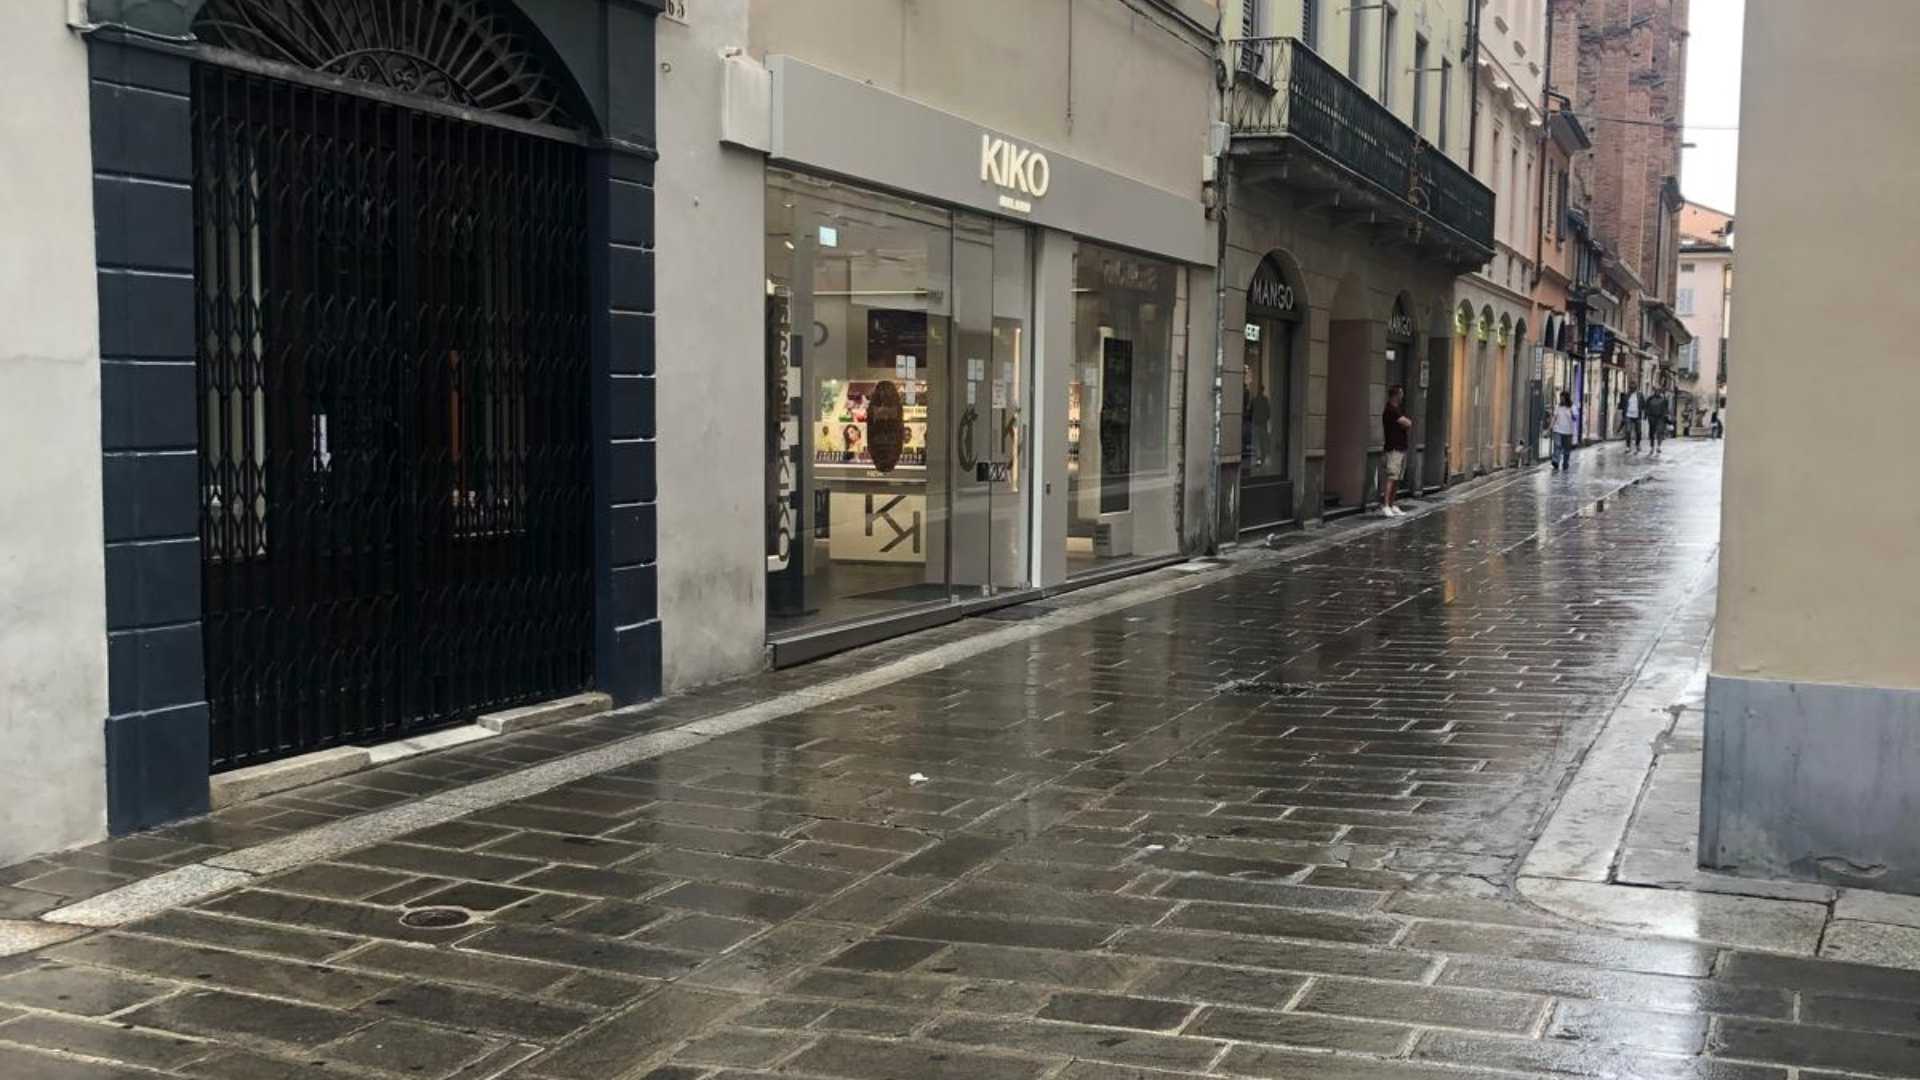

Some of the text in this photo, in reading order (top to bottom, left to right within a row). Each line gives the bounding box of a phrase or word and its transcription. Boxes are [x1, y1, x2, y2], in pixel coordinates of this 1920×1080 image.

[981, 134, 1049, 197] KIKO
[1253, 278, 1294, 311] MANGO
[1391, 312, 1413, 337] ANGO
